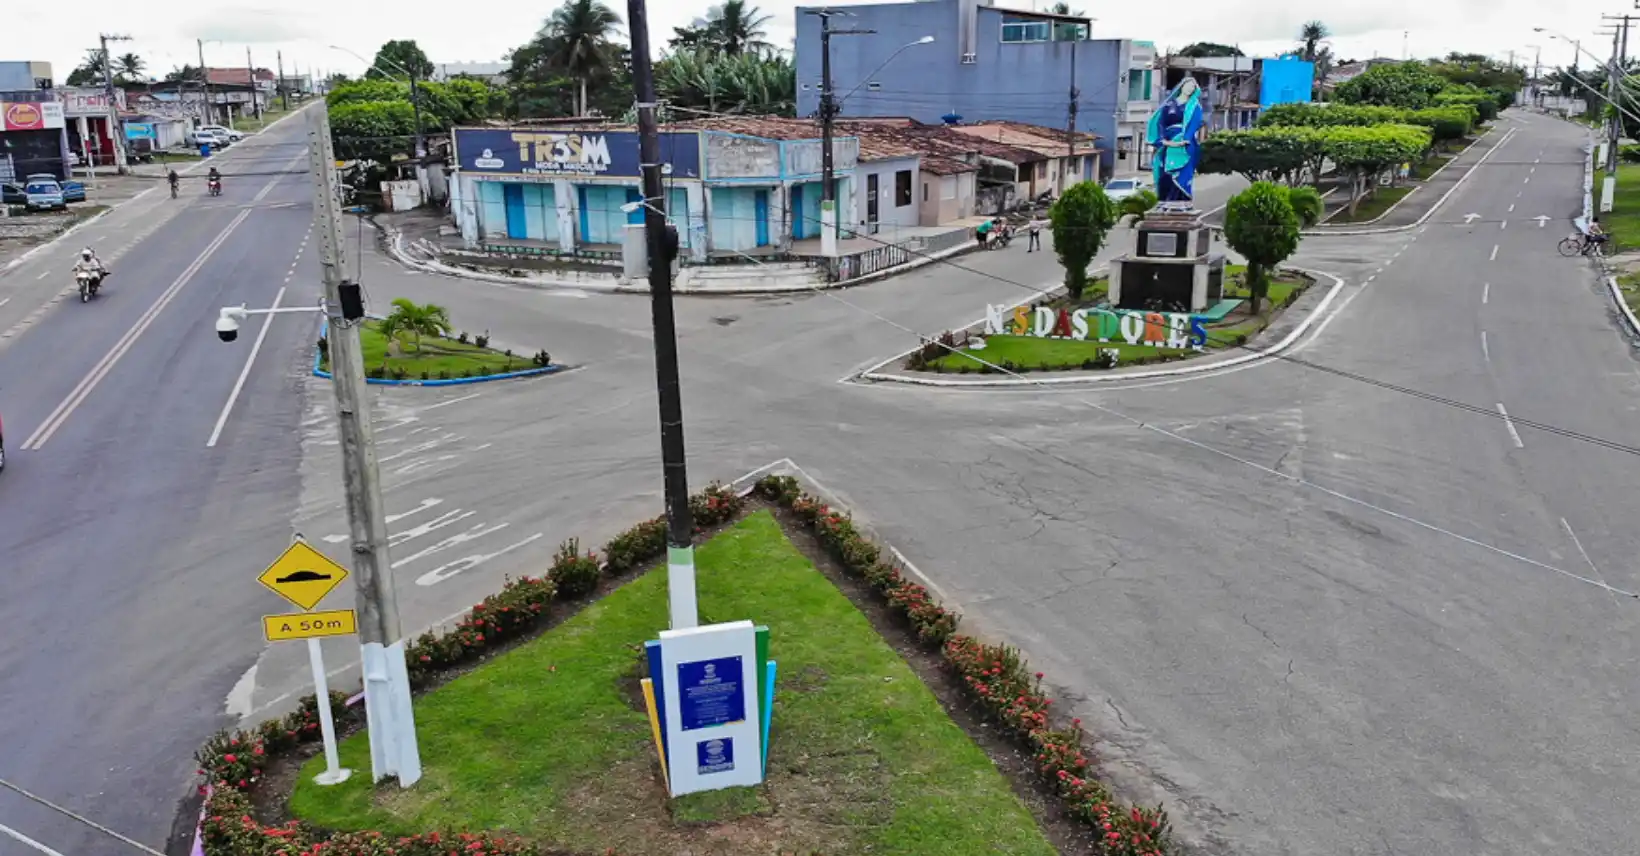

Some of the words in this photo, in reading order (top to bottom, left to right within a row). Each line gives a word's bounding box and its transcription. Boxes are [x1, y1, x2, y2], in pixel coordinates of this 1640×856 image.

[1096, 309, 1209, 349] DORES
[280, 622, 292, 632] A
[300, 620, 341, 631] 50m
